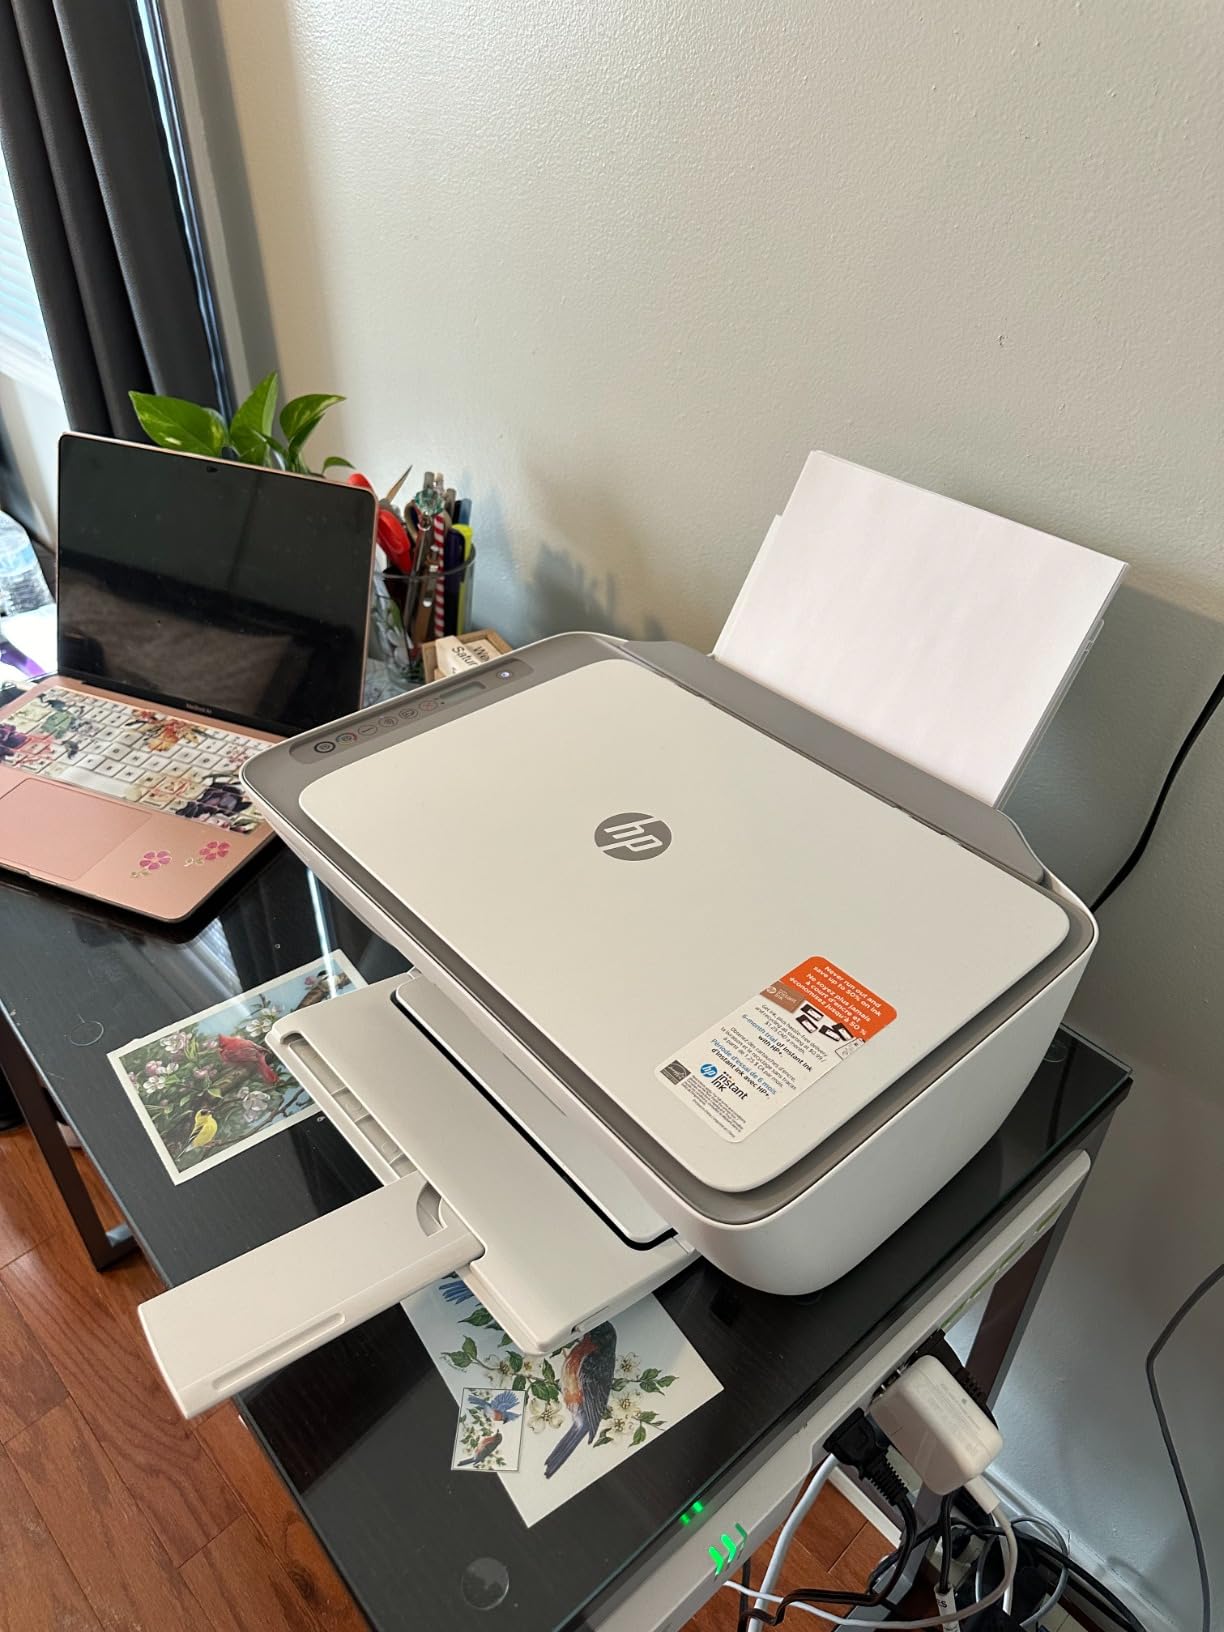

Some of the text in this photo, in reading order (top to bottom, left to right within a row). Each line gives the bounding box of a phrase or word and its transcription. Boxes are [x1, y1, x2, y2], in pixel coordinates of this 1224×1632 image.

[452, 646, 478, 666] Satur
[594, 812, 672, 861] hp
[806, 973, 872, 1022] Ne soyez plus jamais
[810, 984, 828, 998] court
[827, 997, 853, 1016] d'encre
[813, 966, 828, 977] save
[845, 989, 861, 1001] 50%
[824, 966, 882, 1008] Never run out and
[789, 977, 827, 1005] économisez
[824, 1003, 850, 1022] jusqu'à
[849, 1021, 860, 1030] 50
[741, 1014, 766, 1034] 6-month
[764, 1032, 778, 1043] trial
[757, 1035, 771, 1046] with
[700, 1064, 717, 1077] hp
[710, 1038, 733, 1057] Période
[730, 1055, 752, 1072] d'essai
[749, 1071, 759, 1079] de
[761, 1081, 777, 1095] mois
[743, 1075, 758, 1087] avec
